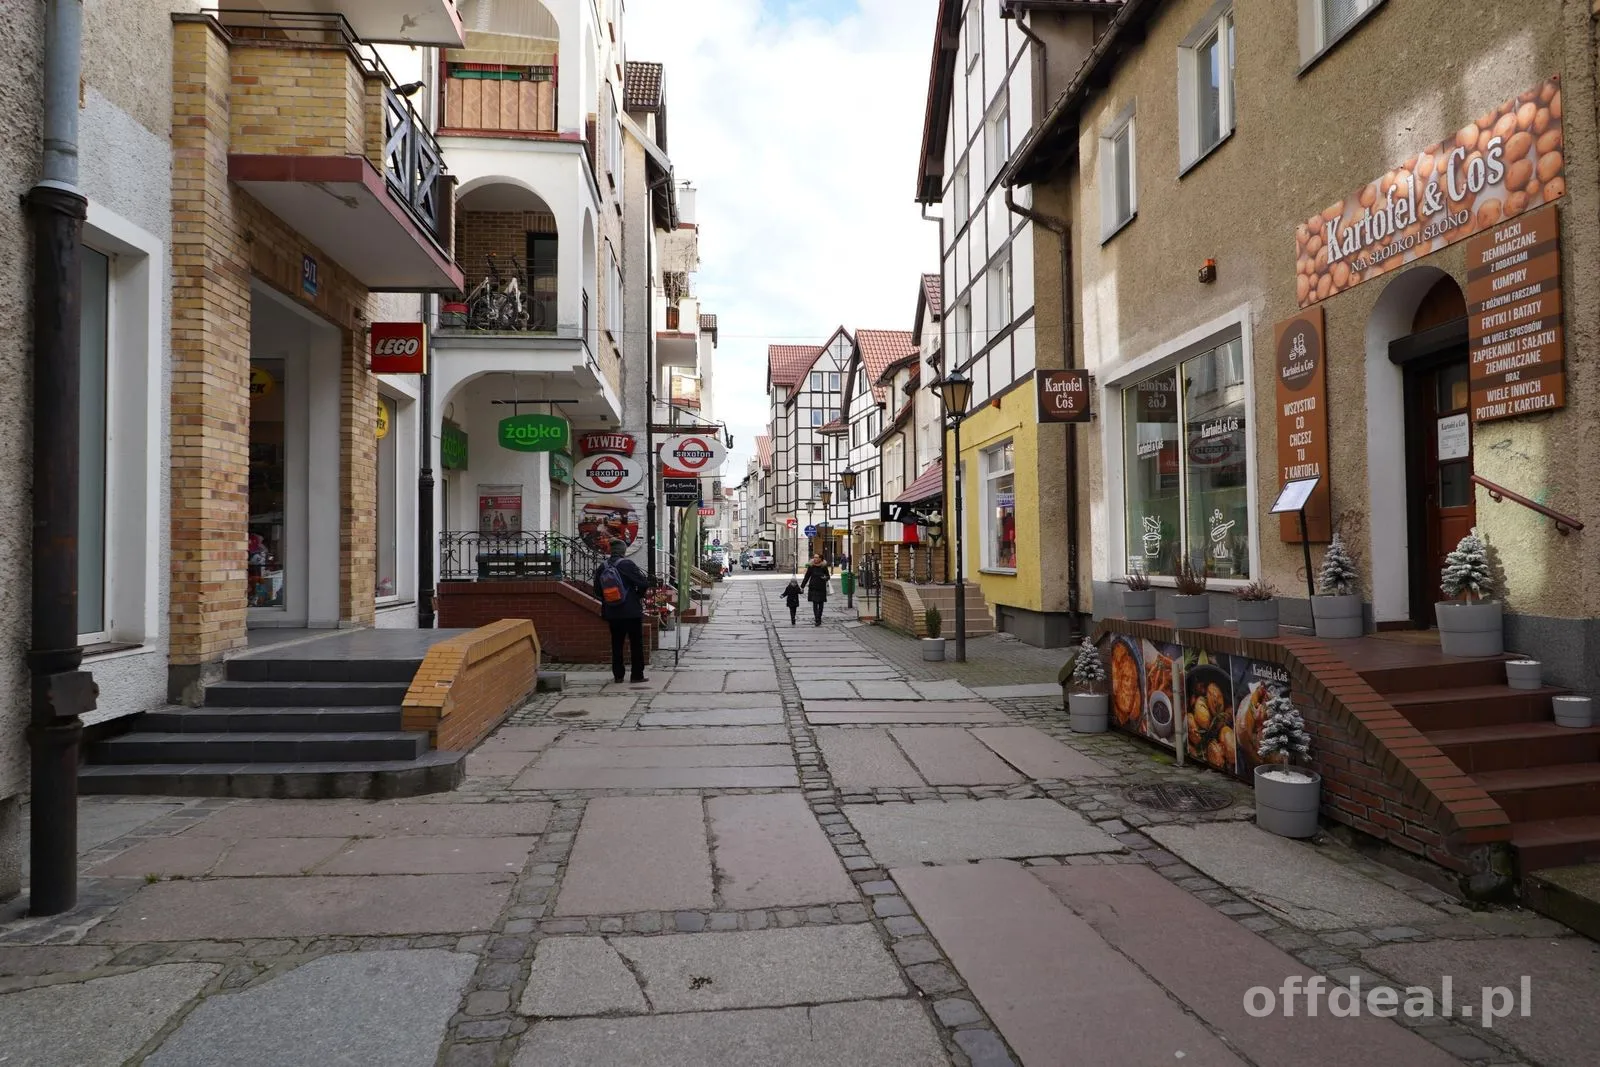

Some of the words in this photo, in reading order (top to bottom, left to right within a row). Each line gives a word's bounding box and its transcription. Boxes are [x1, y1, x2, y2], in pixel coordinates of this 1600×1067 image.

[1326, 175, 1416, 265] Kartofel
[1422, 182, 1442, 215] &
[1351, 259, 1367, 273] NA
[1370, 238, 1414, 267] SŁODKO
[1416, 237, 1422, 246] I
[1423, 210, 1468, 241] SŁONO
[1495, 223, 1521, 243] PLACKI
[1482, 231, 1536, 263] ZIEMNIACZANE
[1495, 252, 1528, 271] DODATKAMI
[1492, 268, 1527, 291] KUMPIRY
[1486, 293, 1511, 309] RÓŻNYMI
[1512, 284, 1541, 302] FARSZAMI
[1482, 311, 1507, 330] FRYTKI
[1513, 301, 1542, 320] BATATY
[1482, 335, 1490, 346] NA
[1491, 330, 1508, 343] WIELE
[1509, 321, 1542, 338] SPOSOBÓW
[375, 338, 419, 355] LEGO
[1473, 341, 1515, 363] ZAPIEKANKI
[1522, 331, 1555, 350] SAŁATKI
[1485, 350, 1541, 375] ZIEMNIACZANE
[1045, 378, 1083, 392] Kartofel
[1505, 371, 1520, 383] ORAZ
[1486, 387, 1509, 402] WIELE
[1511, 380, 1541, 397] INNYCH
[1284, 397, 1316, 416] WSZYSTKO
[1476, 400, 1506, 419] POTRAW
[1508, 402, 1513, 414] Z
[1514, 393, 1555, 412] KARTOFLA
[505, 423, 561, 439] żabka
[1201, 419, 1222, 438] Kartofel
[1223, 423, 1227, 432] &
[1296, 416, 1304, 430] CO
[587, 434, 628, 449] ŻYWIEC
[1290, 431, 1312, 447] CHCESZ
[1297, 448, 1305, 462] TU
[1285, 467, 1289, 479] Z
[1289, 463, 1320, 479] KARTOFLA
[1252, 664, 1272, 679] Kartofel
